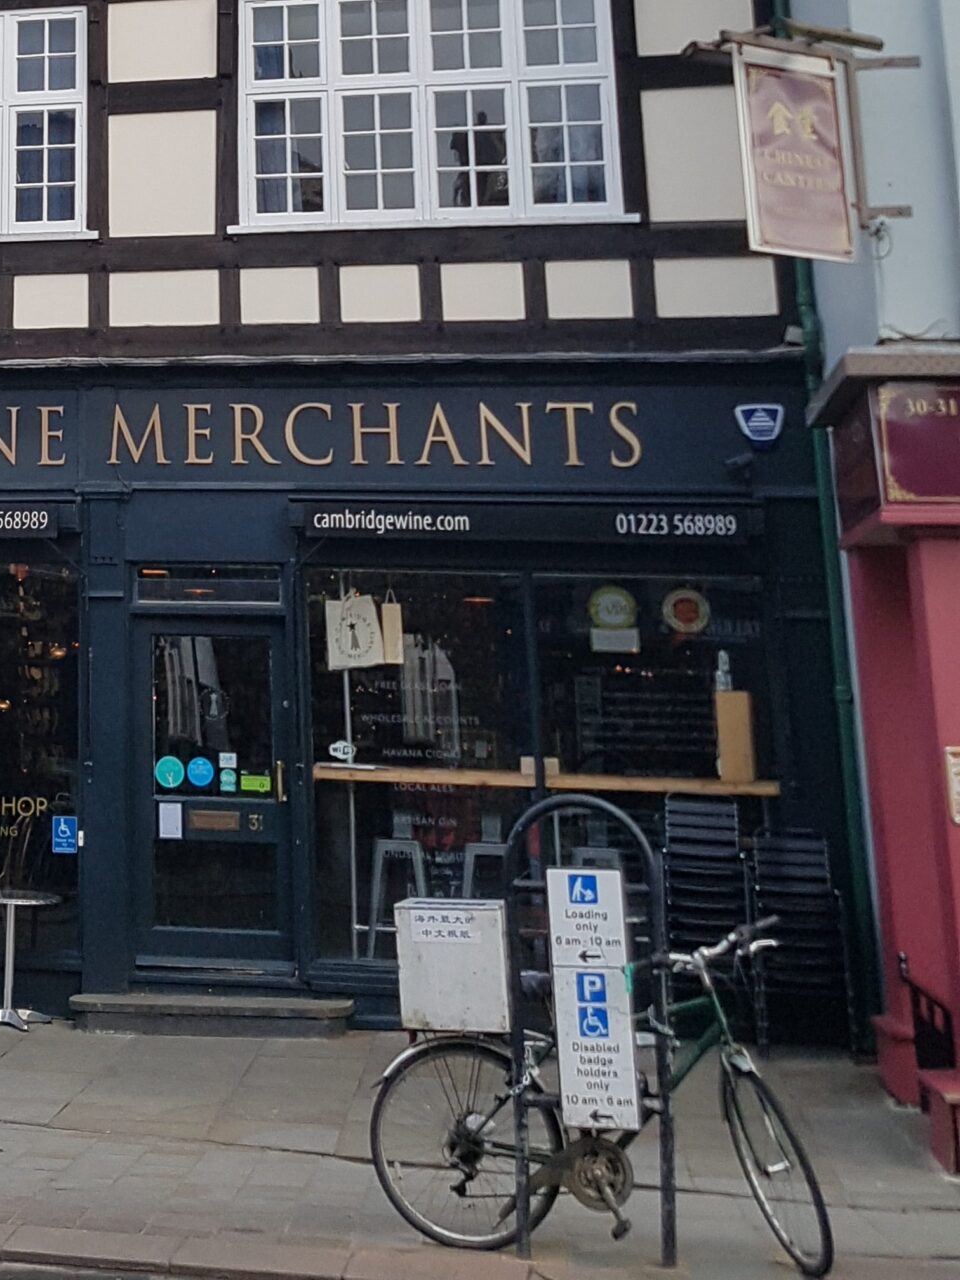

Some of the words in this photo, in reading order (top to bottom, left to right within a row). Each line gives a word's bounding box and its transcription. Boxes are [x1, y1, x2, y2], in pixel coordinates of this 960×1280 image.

[106, 401, 642, 468] MERCHANTS
[313, 509, 470, 534] cambridgewine.com
[615, 513, 669, 534] 01223
[672, 513, 737, 536] 568989
[565, 909, 608, 921] Loading
[575, 922, 598, 933] only
[590, 937, 603, 946] 10
[605, 938, 622, 947] am
[572, 1041, 620, 1054] Disabled
[580, 1054, 613, 1067] badge
[576, 1066, 618, 1078] holders
[586, 1079, 610, 1091] only
[566, 1095, 579, 1105] 10
[582, 1097, 598, 1106] am
[616, 1098, 634, 1107] am
